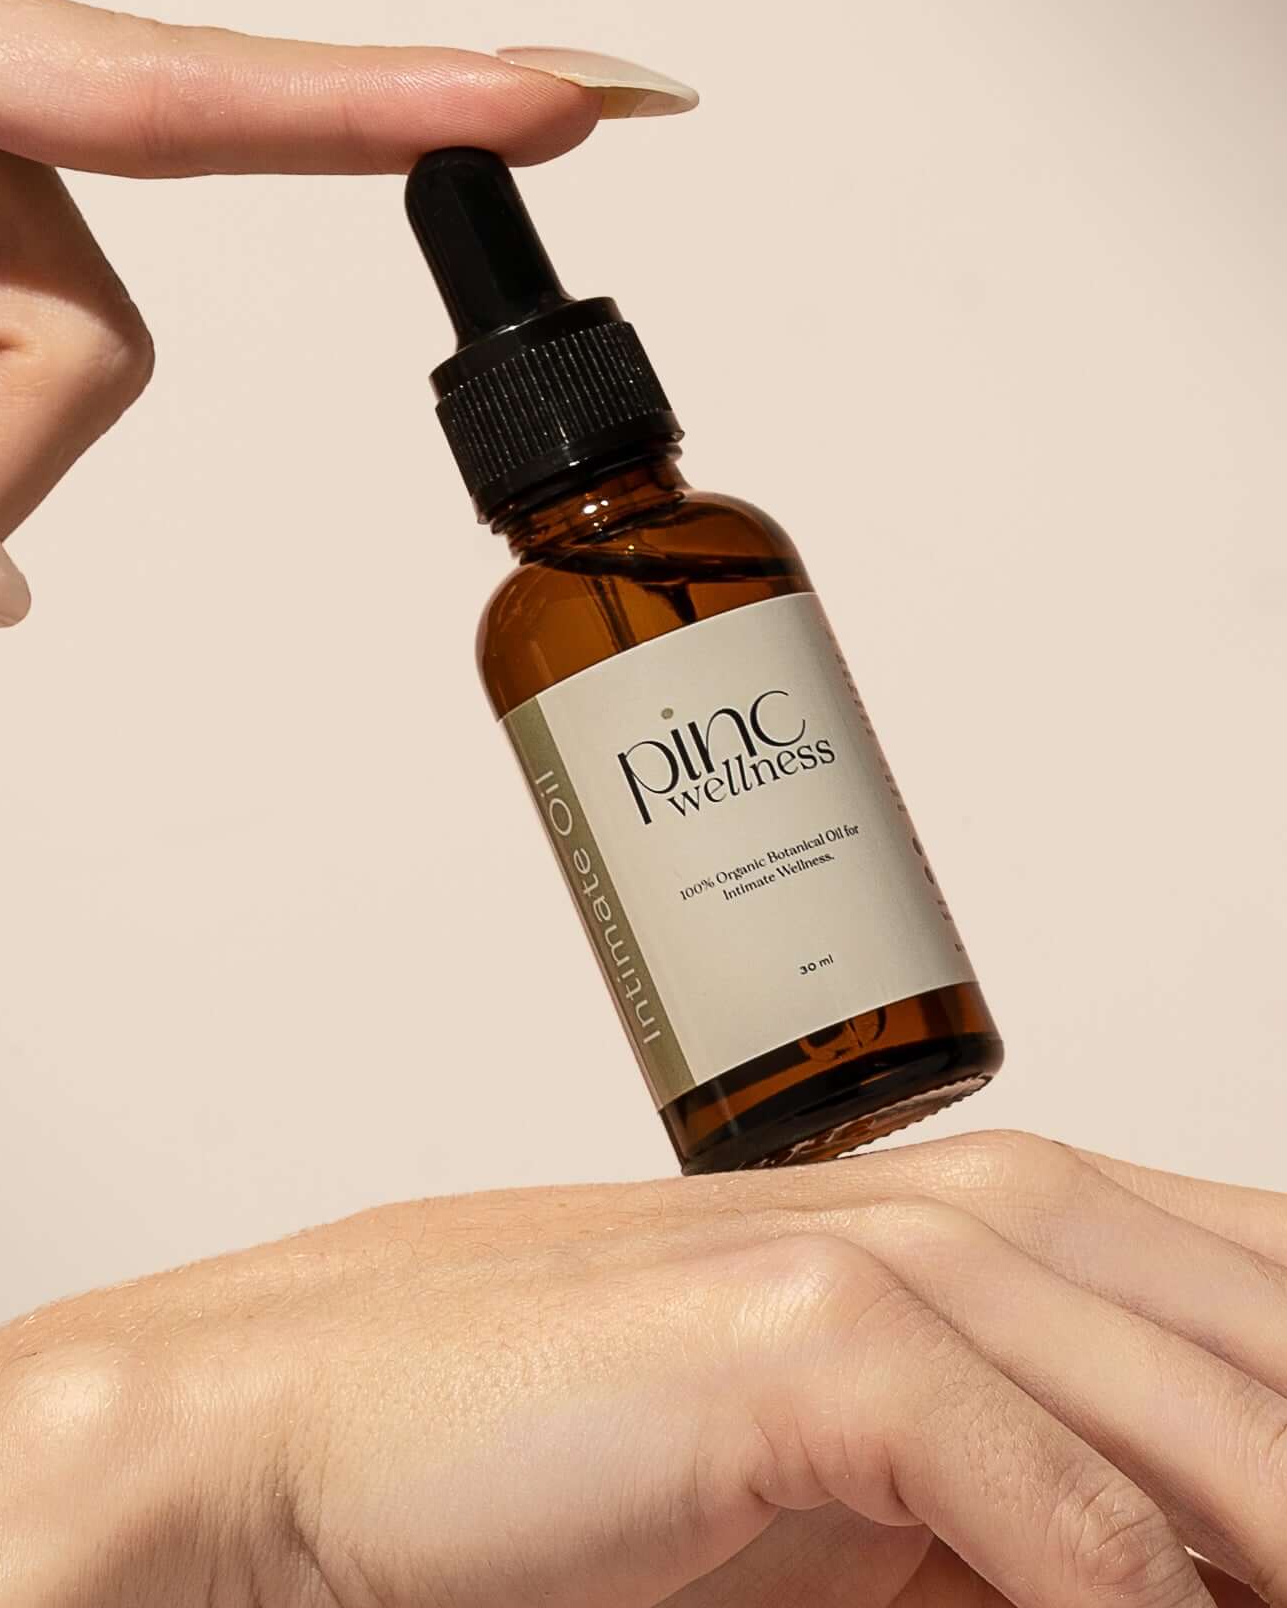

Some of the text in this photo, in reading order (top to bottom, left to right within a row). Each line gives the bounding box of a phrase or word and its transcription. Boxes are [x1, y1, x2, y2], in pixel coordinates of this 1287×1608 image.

[617, 690, 806, 825] pinc
[667, 738, 836, 817] wellness
[679, 824, 860, 901] 100% Organic Botanical Oil for
[722, 852, 835, 901] Intimate Wellness.
[535, 770, 661, 1044] Intimate Oil
[799, 954, 834, 975] 30 ml
